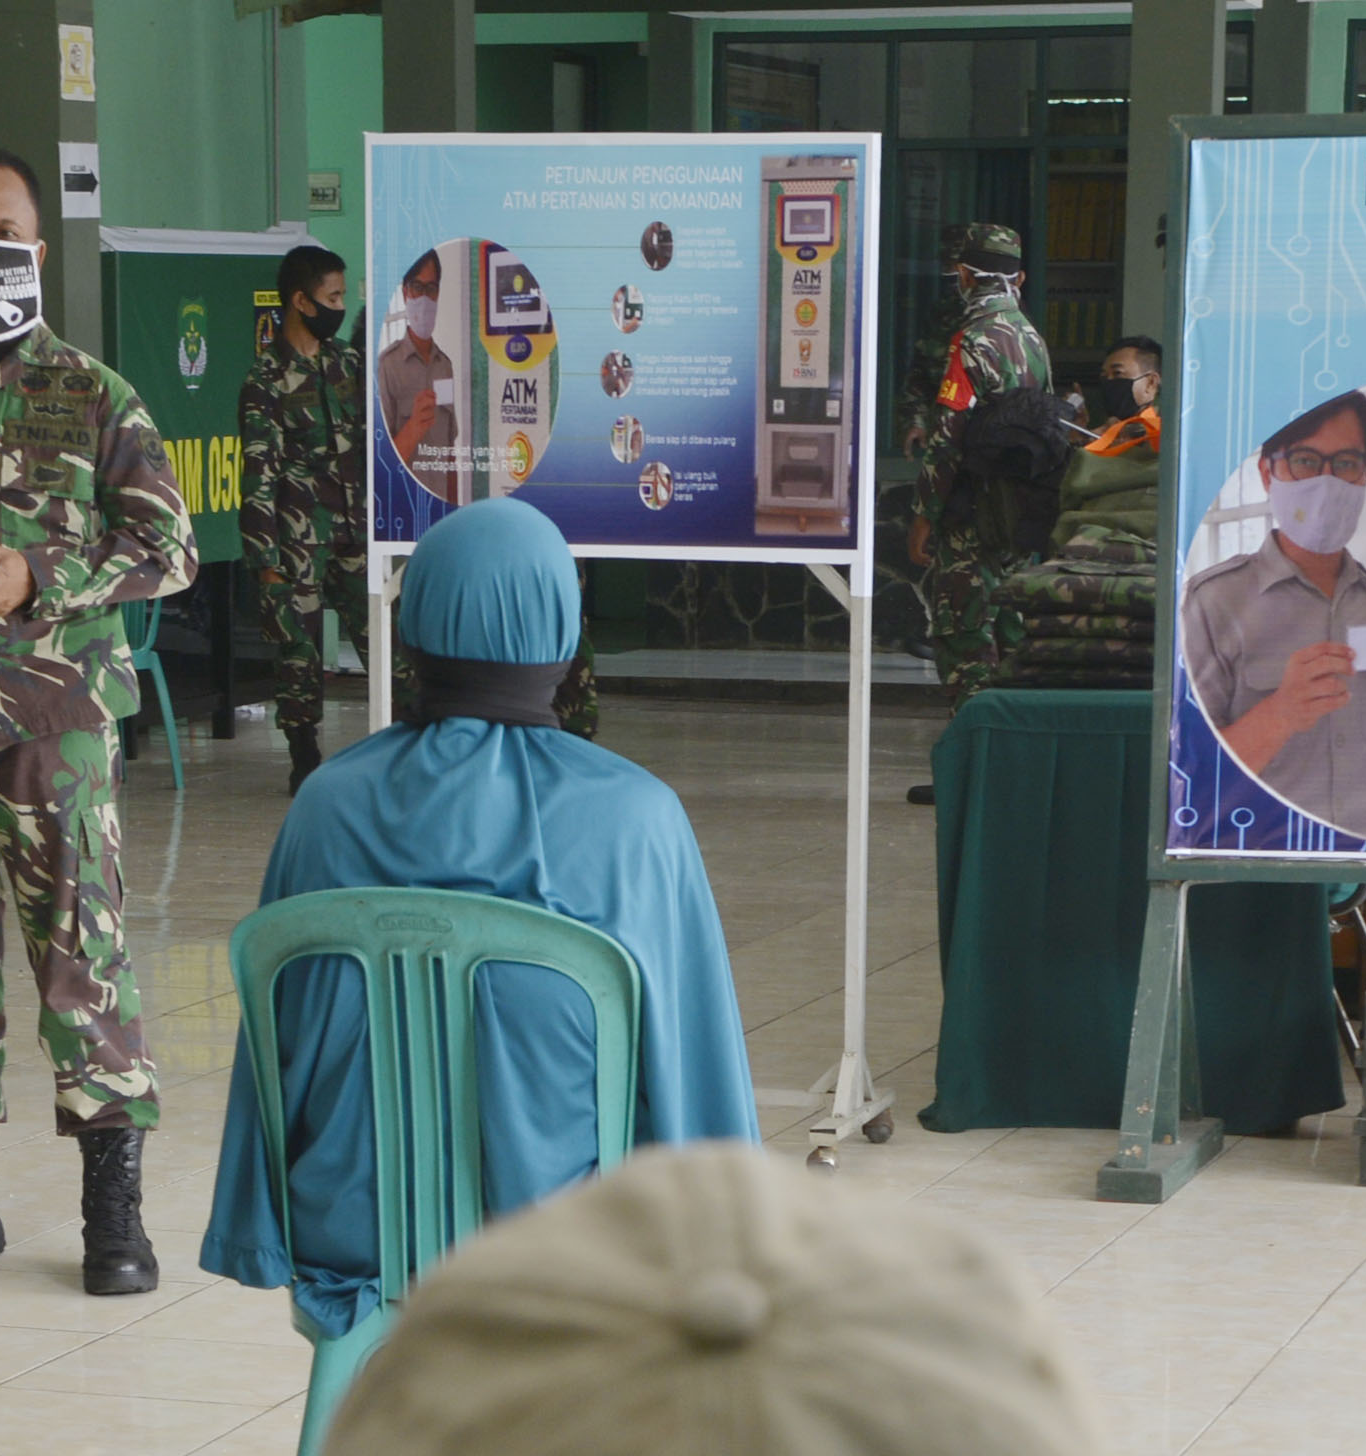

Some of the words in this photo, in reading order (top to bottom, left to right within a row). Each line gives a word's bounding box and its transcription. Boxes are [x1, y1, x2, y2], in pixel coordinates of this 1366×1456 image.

[545, 166, 628, 184] PETUNJUK
[633, 166, 743, 184] PENGGUNAAN
[502, 191, 537, 209] ATM
[541, 191, 627, 209] PERTANIAN
[631, 191, 645, 209] SI
[650, 191, 743, 209] KOMANDAN
[794, 270, 821, 284] ATM
[502, 379, 537, 403] ATM
[13, 423, 91, 445] TNI-AD
[163, 438, 203, 515] DIM
